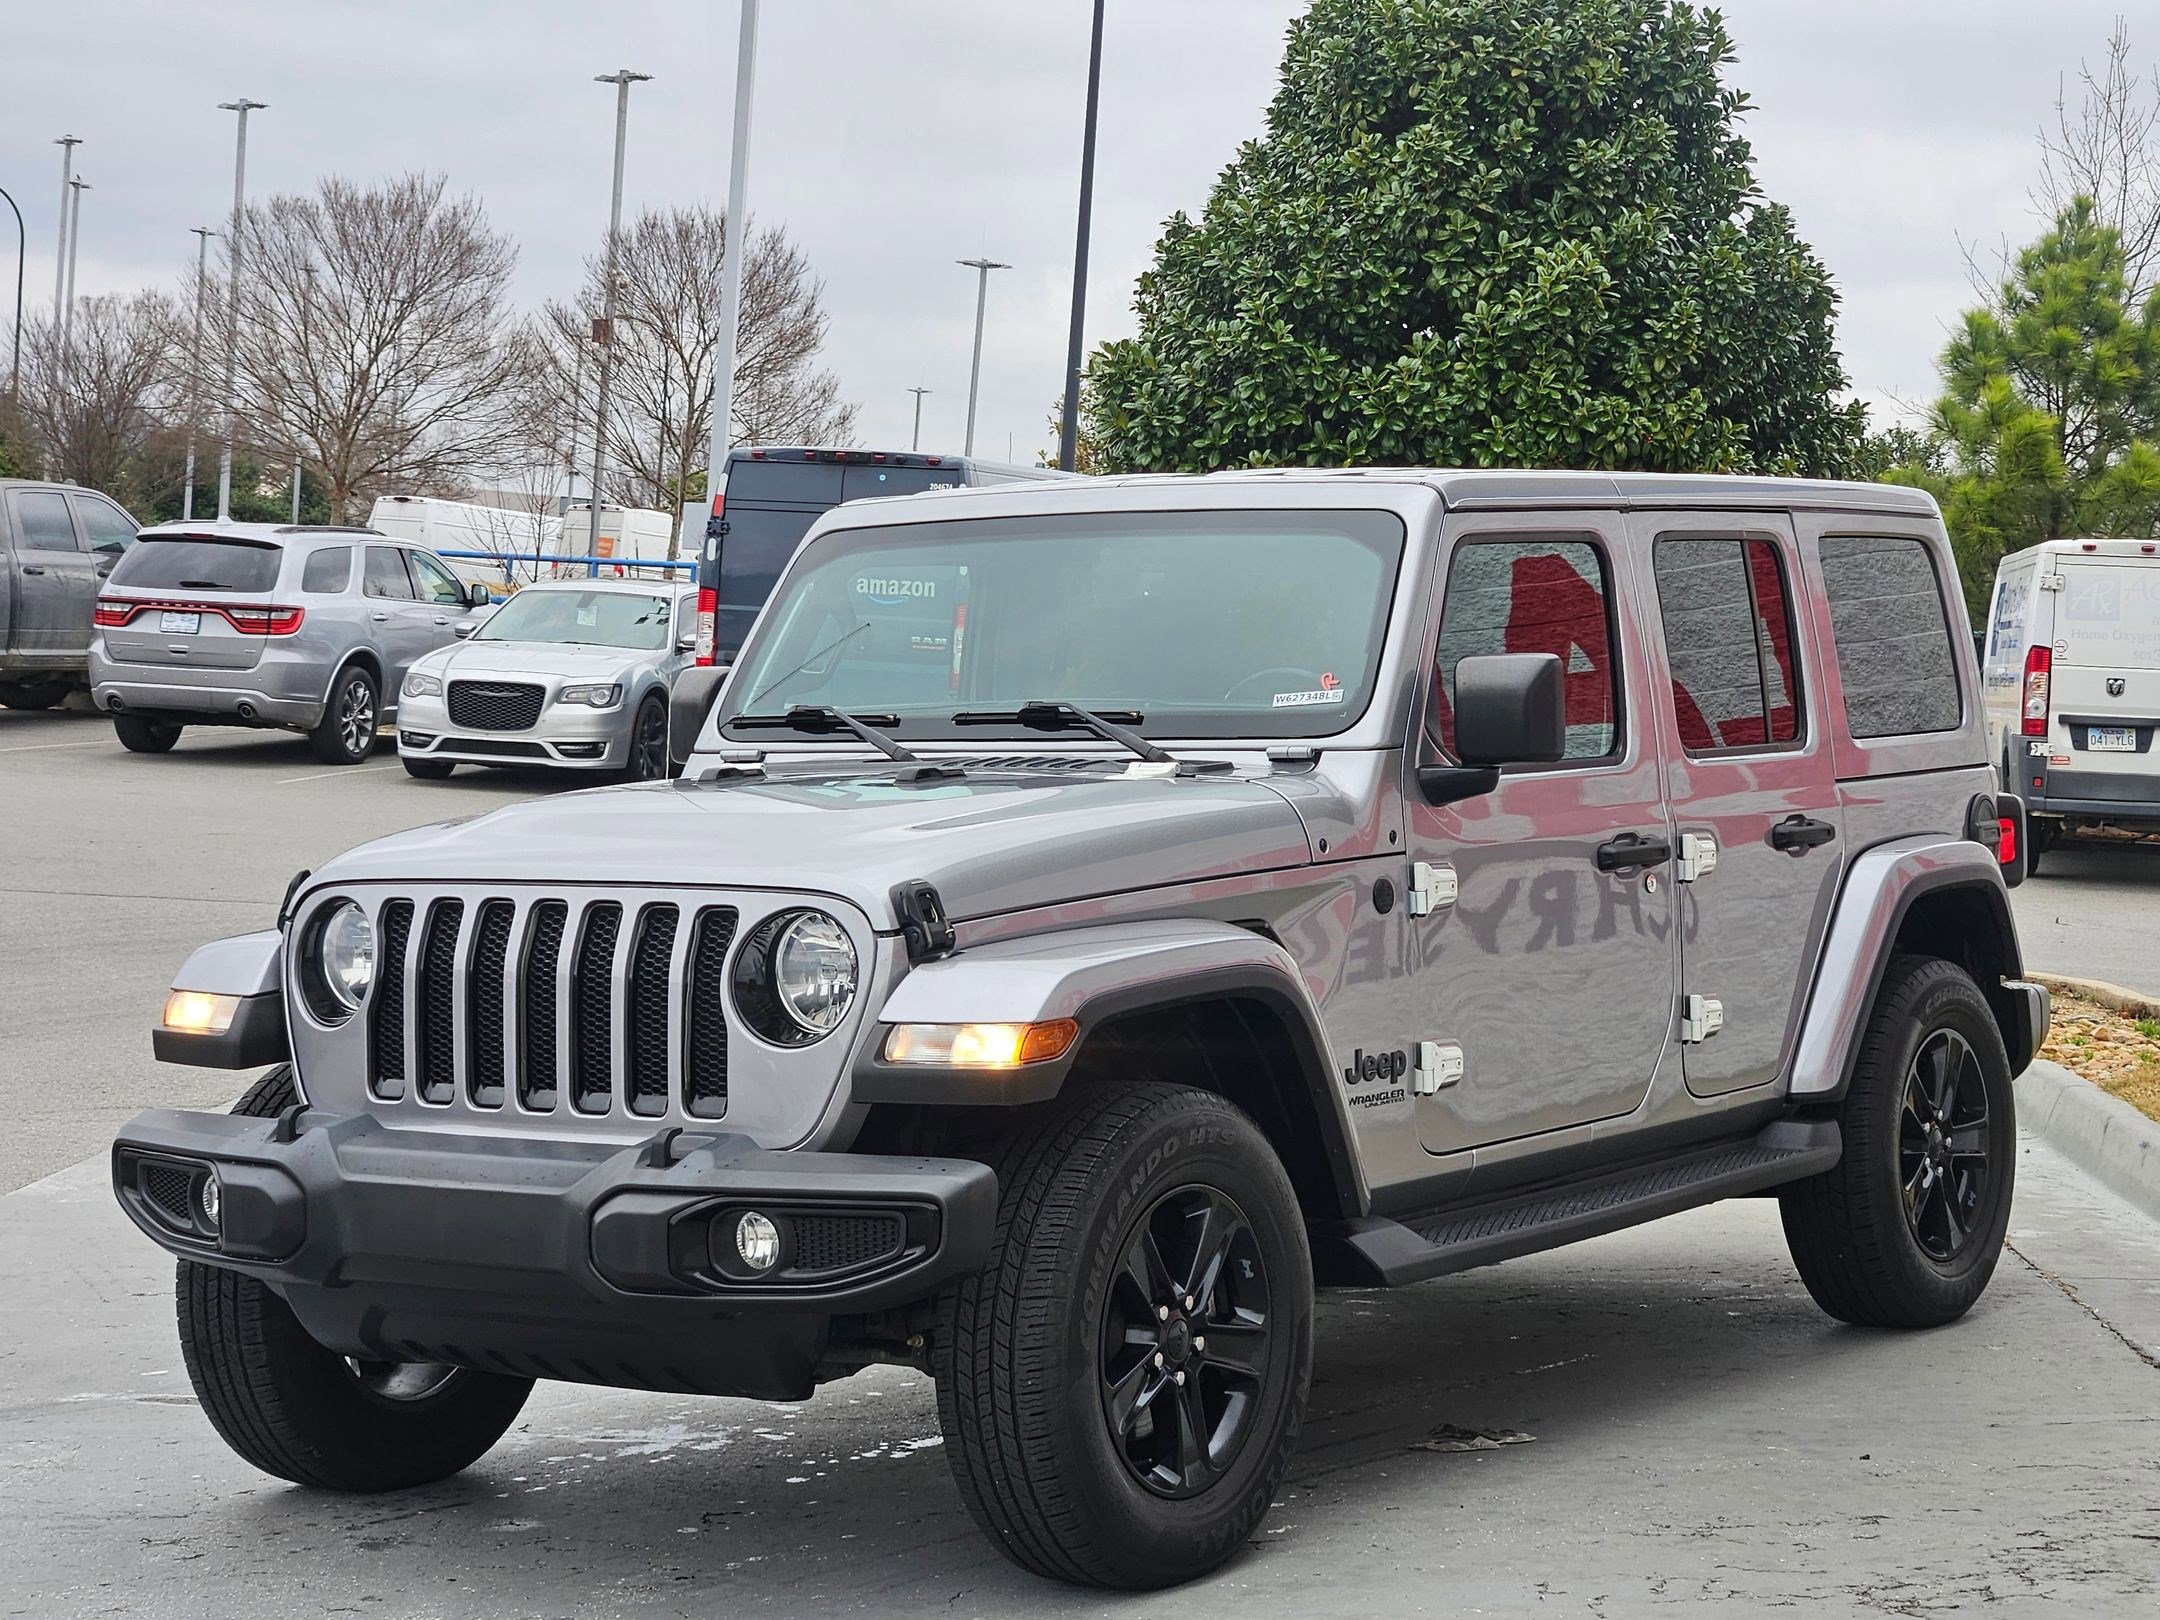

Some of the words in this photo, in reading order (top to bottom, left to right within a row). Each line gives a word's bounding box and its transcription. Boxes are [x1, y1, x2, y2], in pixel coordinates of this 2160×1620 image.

[856, 578, 935, 597] amazon
[2091, 734, 2108, 746] 041
[2116, 735, 2134, 746] YLG
[1345, 1048, 1407, 1085] Jeep
[1349, 1089, 1404, 1106] WRANGLER
[1365, 1097, 1405, 1108] UNLIMITED
[1188, 1126, 1238, 1146] HTS
